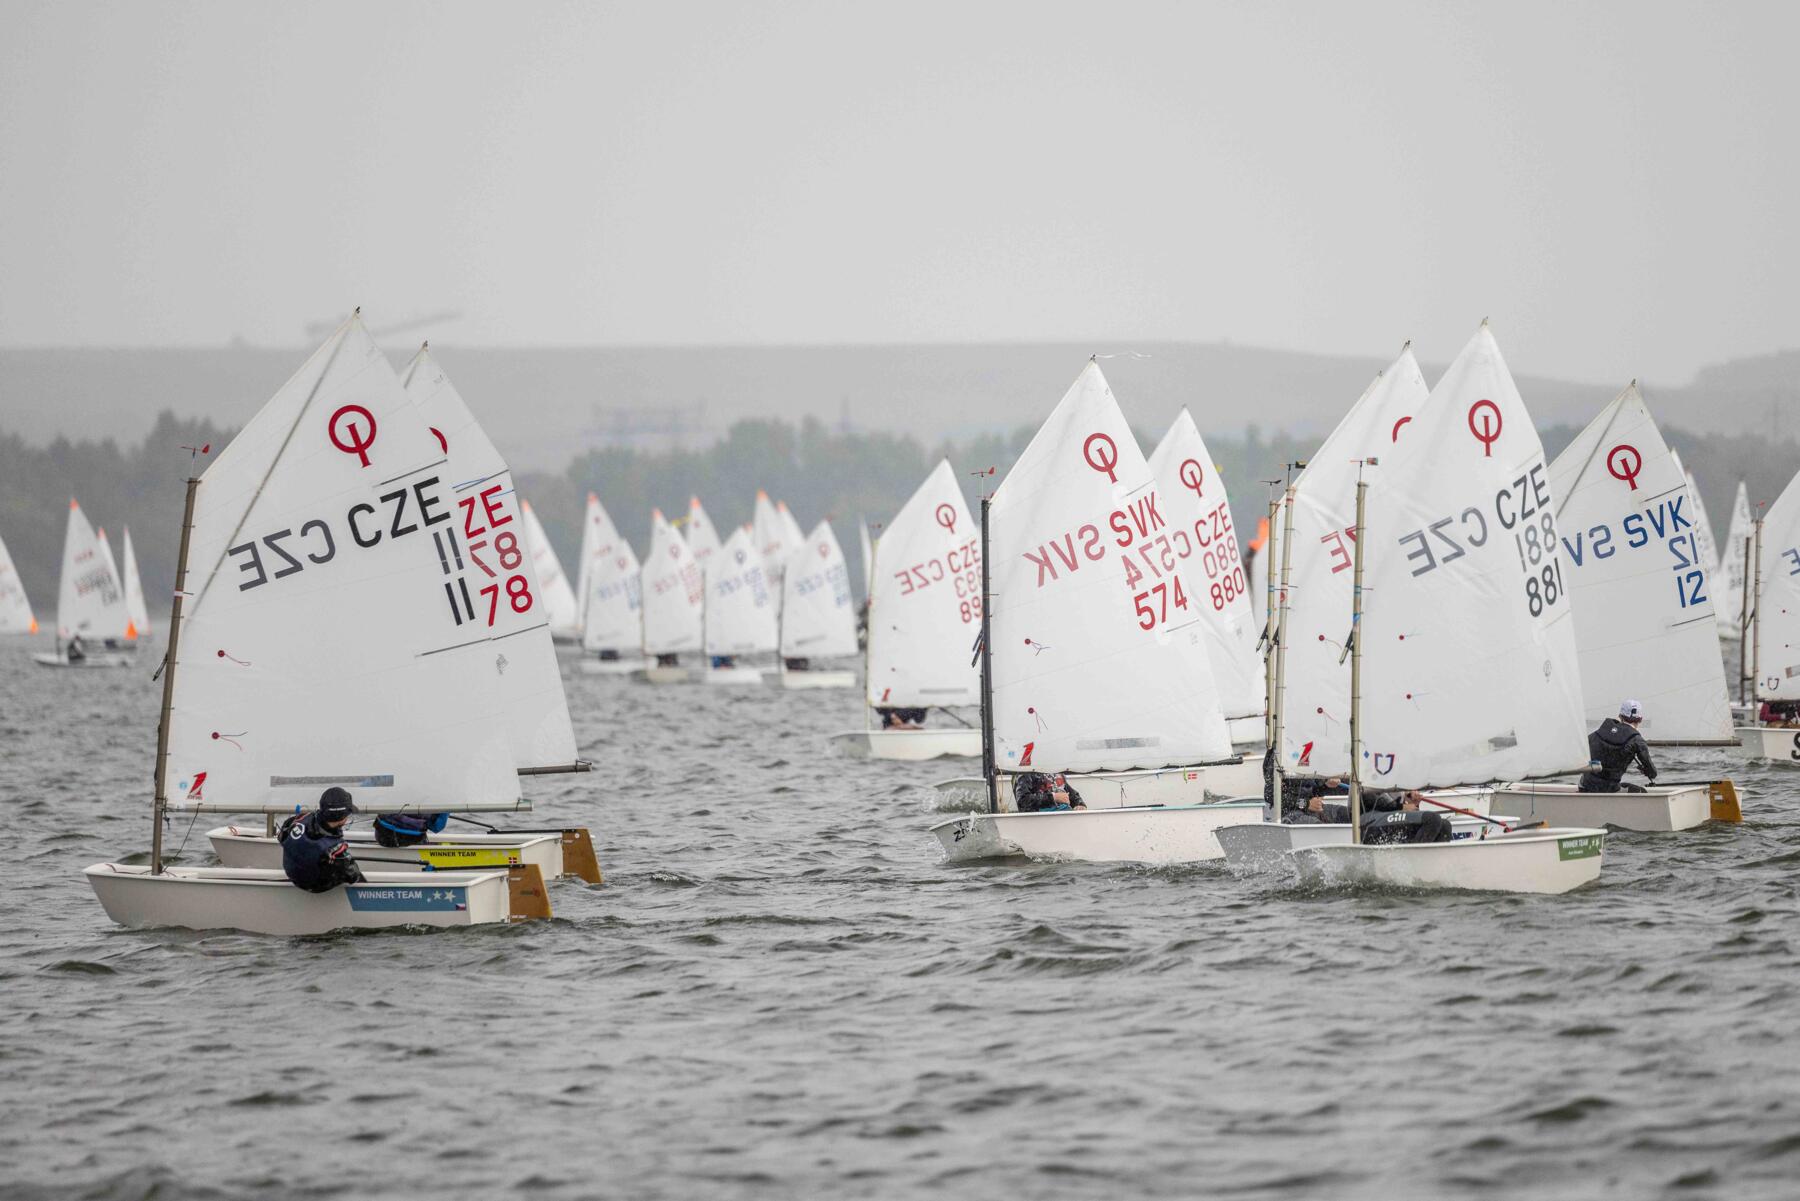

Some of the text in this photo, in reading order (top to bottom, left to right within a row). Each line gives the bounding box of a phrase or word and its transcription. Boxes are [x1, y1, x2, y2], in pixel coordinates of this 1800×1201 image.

[348, 476, 451, 548] CZE
[1109, 491, 1166, 547] SVK
[1496, 463, 1550, 529] CZE
[1195, 502, 1232, 547] CZE
[1623, 495, 1692, 548] SVK
[948, 539, 981, 573] CZE
[1134, 575, 1188, 630] 574
[1211, 566, 1245, 611] 880
[1526, 557, 1563, 617] 881
[1677, 570, 1707, 608] 12
[1387, 812, 1407, 823] Gill
[358, 890, 422, 899] WINNER TEAM
